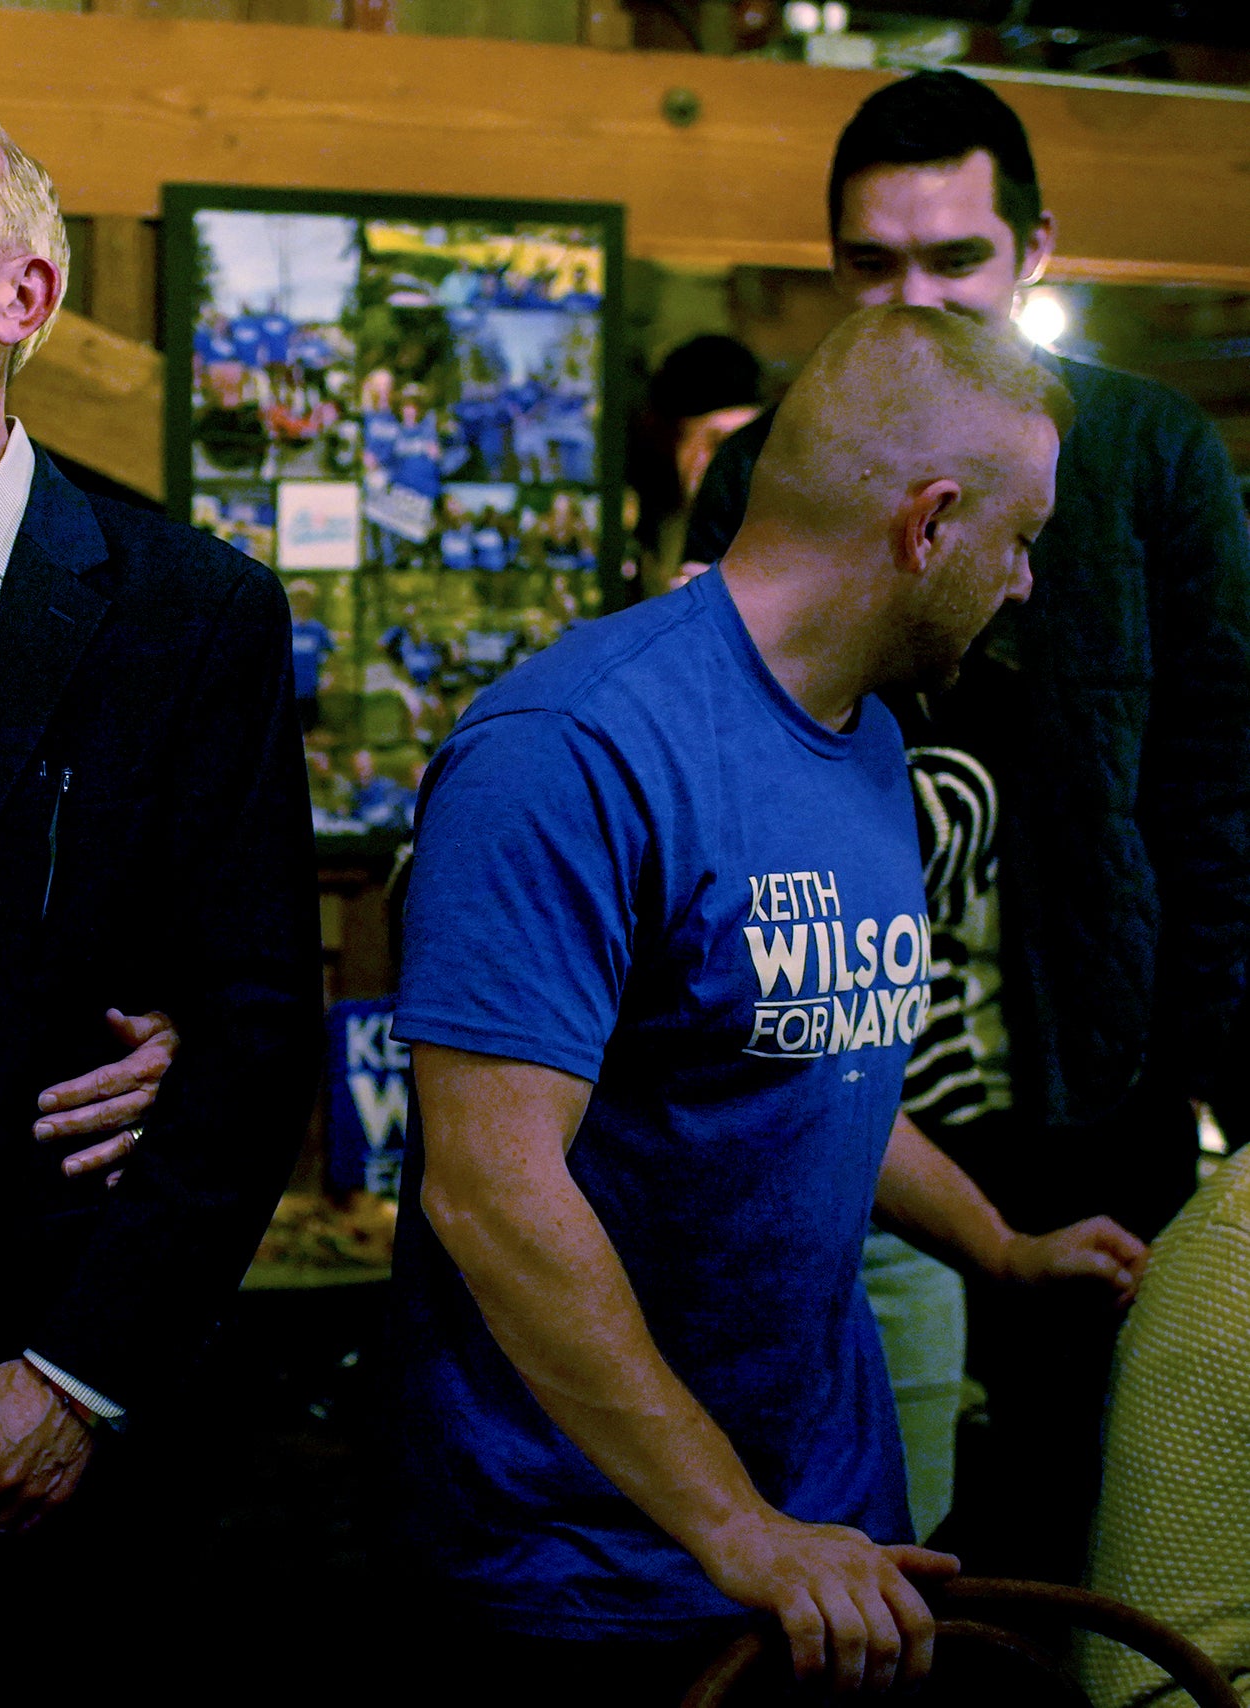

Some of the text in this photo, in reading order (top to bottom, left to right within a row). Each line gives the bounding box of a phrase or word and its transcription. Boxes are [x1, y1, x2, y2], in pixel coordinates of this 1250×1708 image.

[747, 870, 840, 923] KEITH
[743, 912, 932, 998] WILSON
[747, 1006, 828, 1052] FOR
